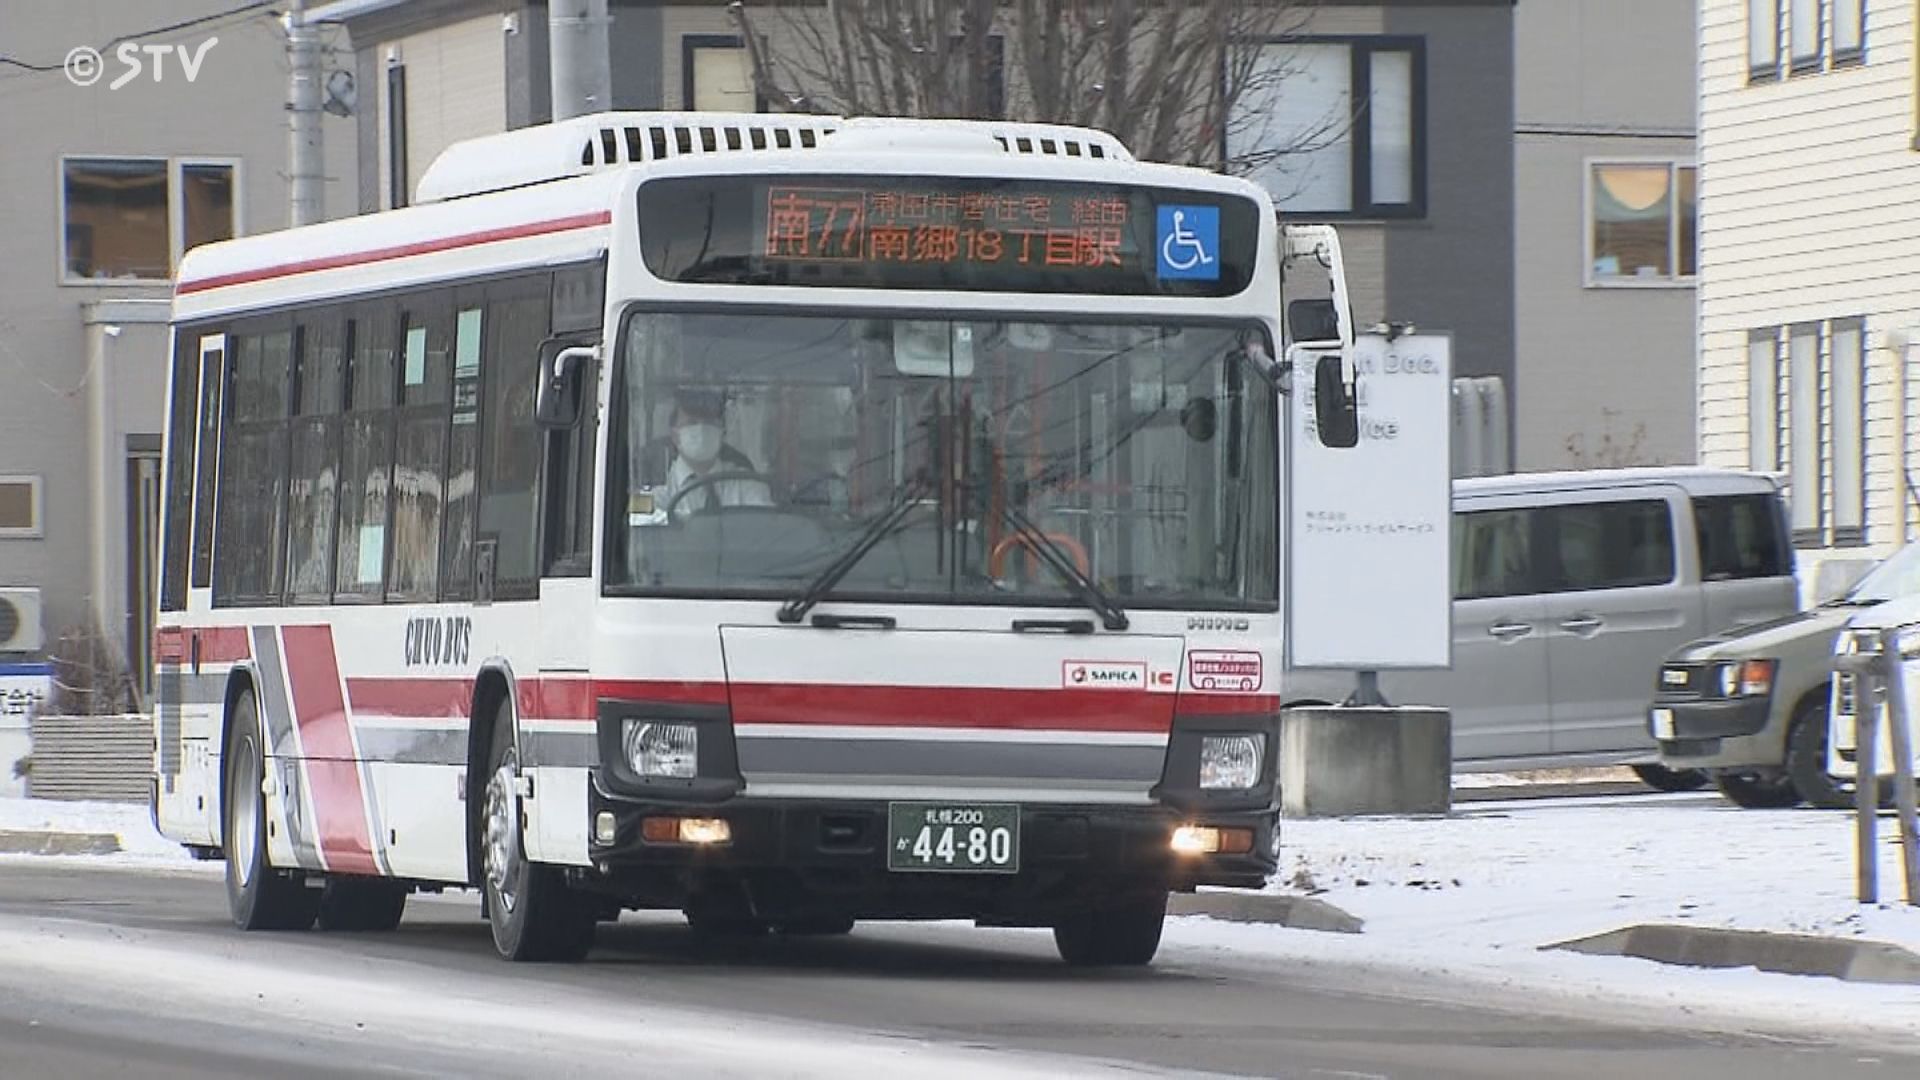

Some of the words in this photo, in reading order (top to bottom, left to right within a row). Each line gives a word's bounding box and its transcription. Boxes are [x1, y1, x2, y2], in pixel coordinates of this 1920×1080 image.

[770, 192, 862, 256] 南77
[869, 219, 1122, 266] 南郷18丁目駅
[405, 617, 442, 667] CHUO
[443, 615, 472, 666] BUS
[1187, 616, 1249, 631] HINO
[1091, 671, 1138, 682] SAPICA
[912, 825, 1010, 864] 44-80
